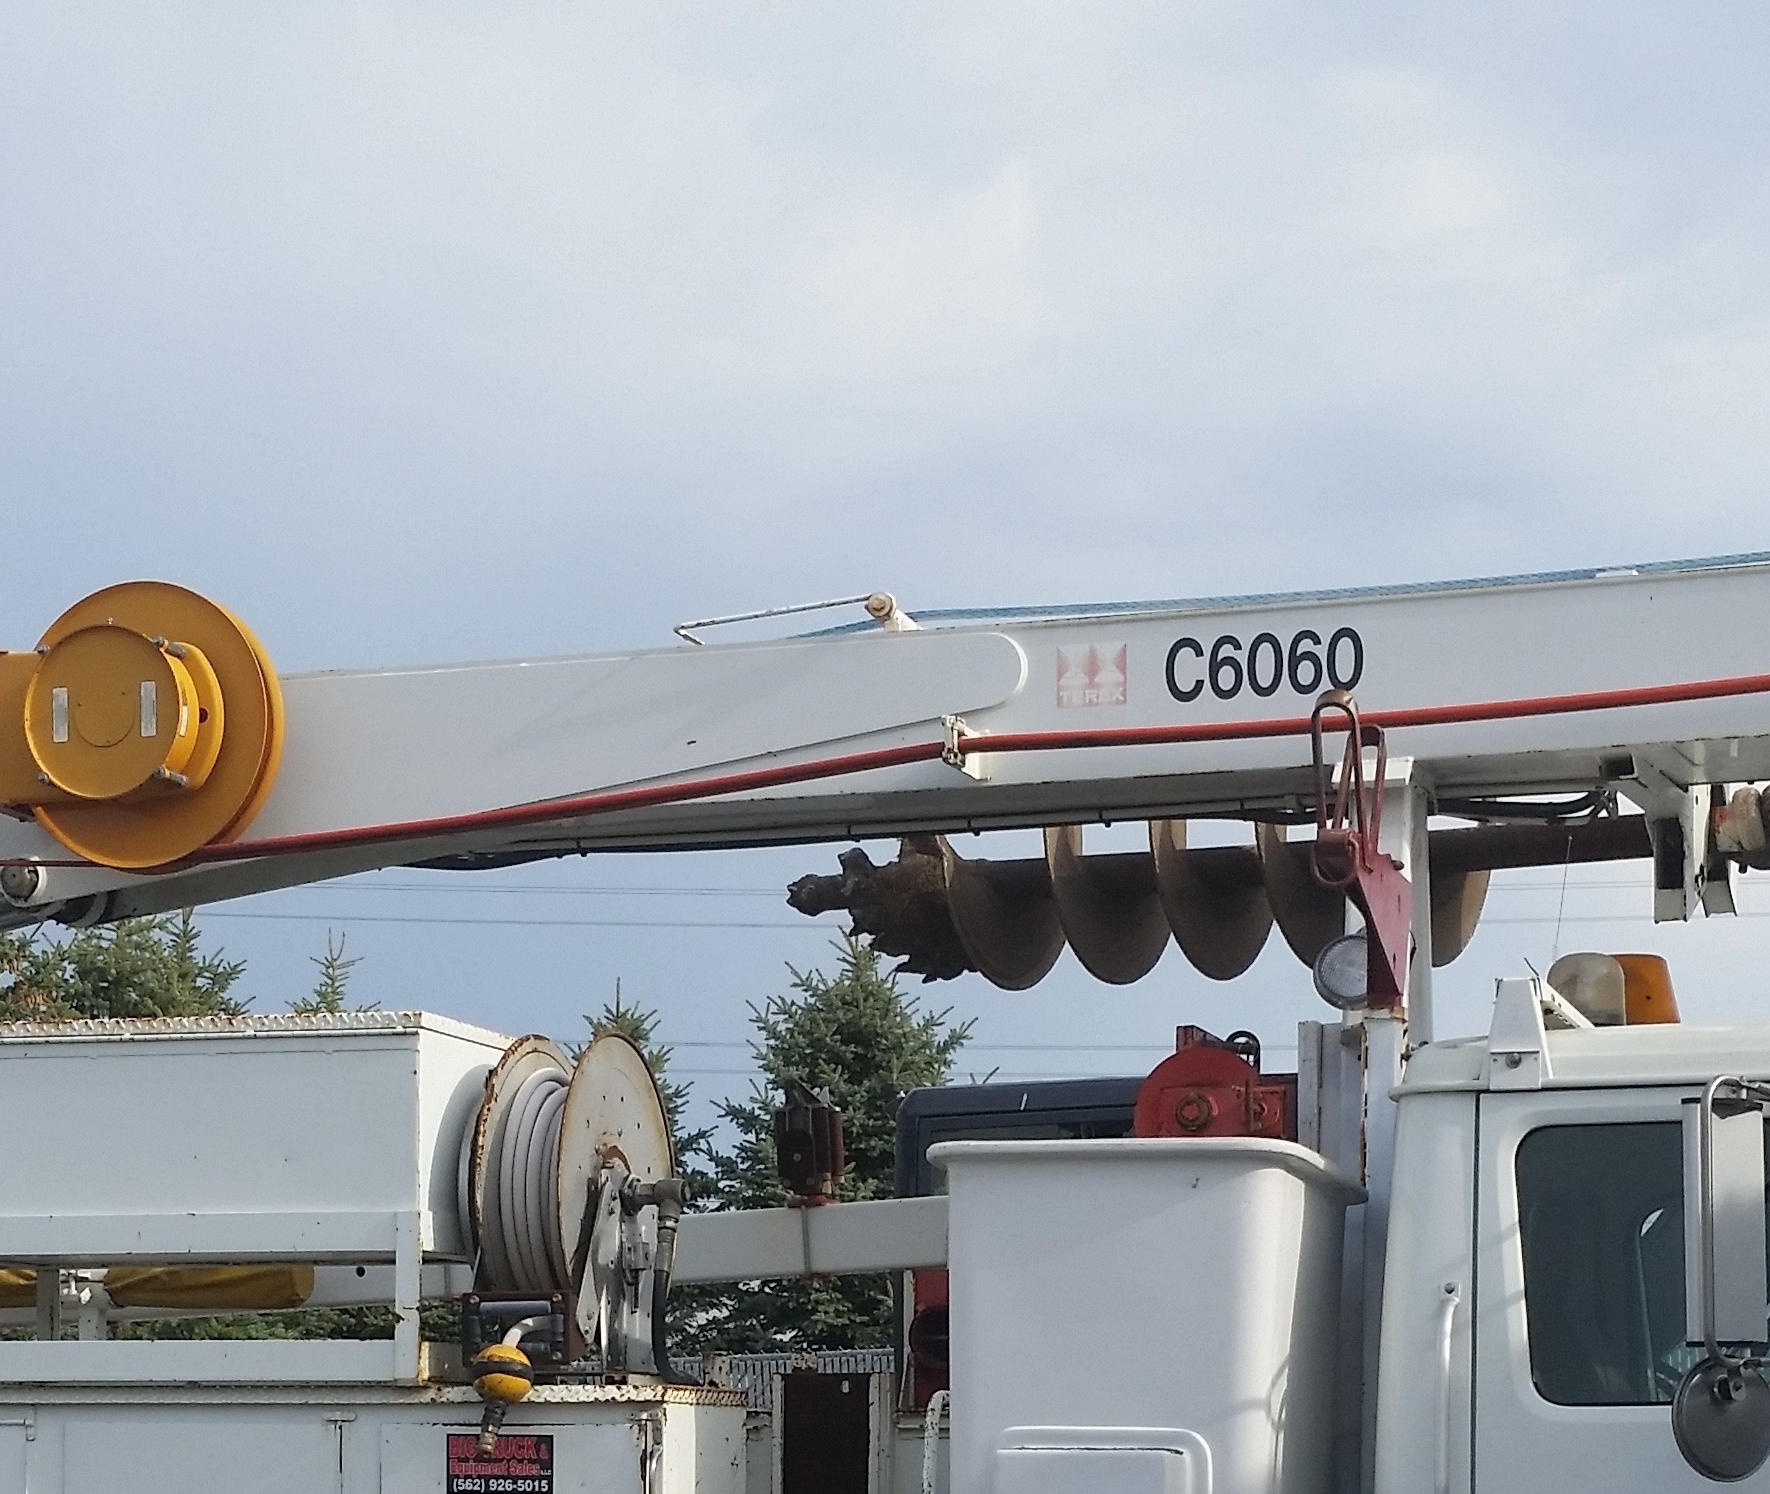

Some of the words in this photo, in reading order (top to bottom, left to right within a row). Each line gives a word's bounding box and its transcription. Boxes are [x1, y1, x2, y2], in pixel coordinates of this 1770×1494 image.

[1165, 627, 1364, 702] C6060
[483, 1437, 537, 1459] RUCK
[449, 1459, 508, 1478] Equipment
[509, 1460, 541, 1476] Sales
[452, 1478, 485, 1493] (562)
[489, 1479, 549, 1492] 926-5015
